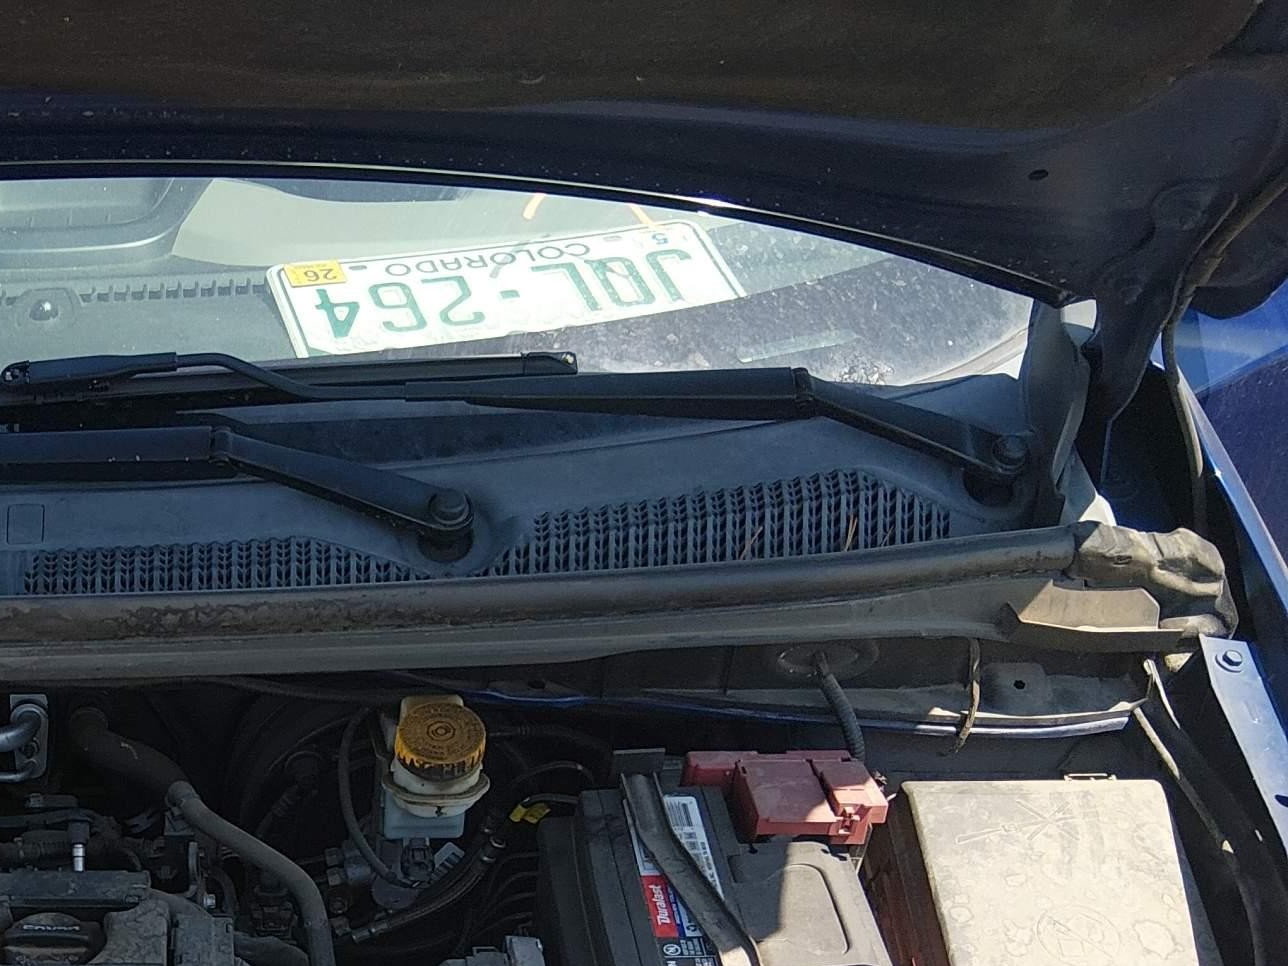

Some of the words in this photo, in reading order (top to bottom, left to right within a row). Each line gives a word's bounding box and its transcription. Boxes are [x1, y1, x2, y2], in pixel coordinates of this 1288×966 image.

[303, 268, 337, 282] 26
[385, 243, 591, 276] COLORADO
[648, 884, 672, 926] Duralast
